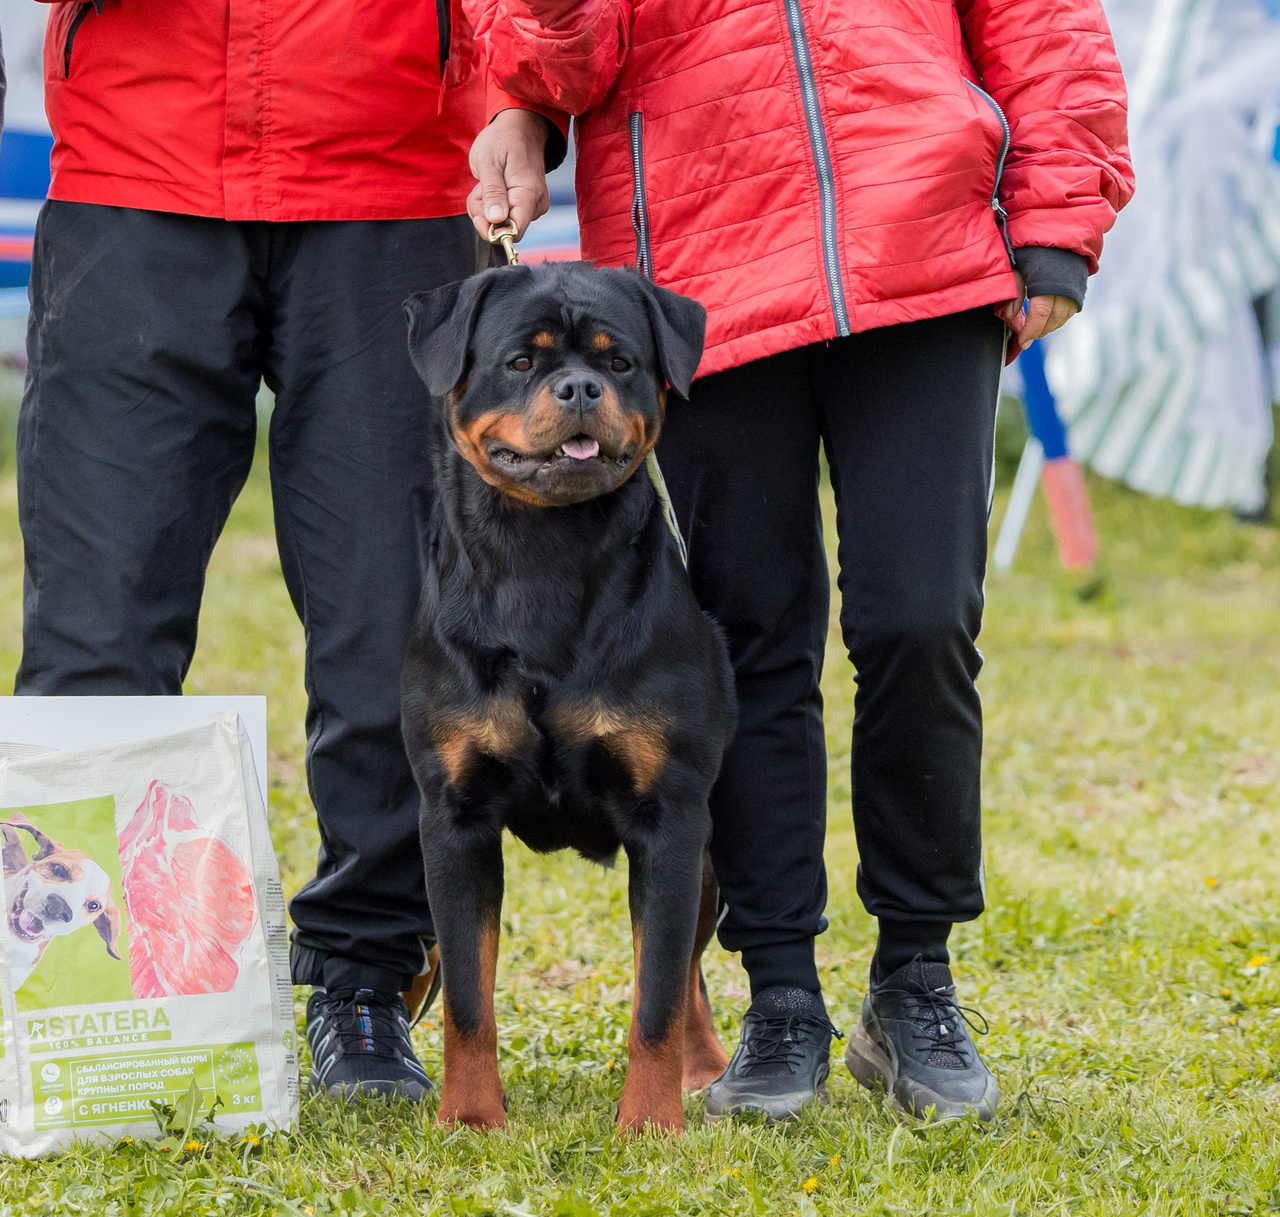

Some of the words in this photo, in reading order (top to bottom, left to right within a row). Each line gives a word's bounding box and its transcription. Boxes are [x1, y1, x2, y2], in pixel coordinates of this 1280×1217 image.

[48, 1006, 171, 1038] STATERA
[49, 1040, 80, 1050] 100%
[86, 1033, 149, 1046] BALANCE
[75, 1055, 179, 1074] СБАЛАНСИРОВАННЫЙ
[180, 1054, 208, 1064] КОРМ
[76, 1075, 99, 1086] ДЛЯ
[100, 1070, 159, 1082] ВЗРОСЛЫХ
[160, 1066, 195, 1078] СОБАК
[77, 1085, 127, 1096] КРУПНЫХ
[128, 1081, 165, 1092] ПОРОД
[232, 1094, 241, 1105] 3
[78, 1104, 89, 1116] С
